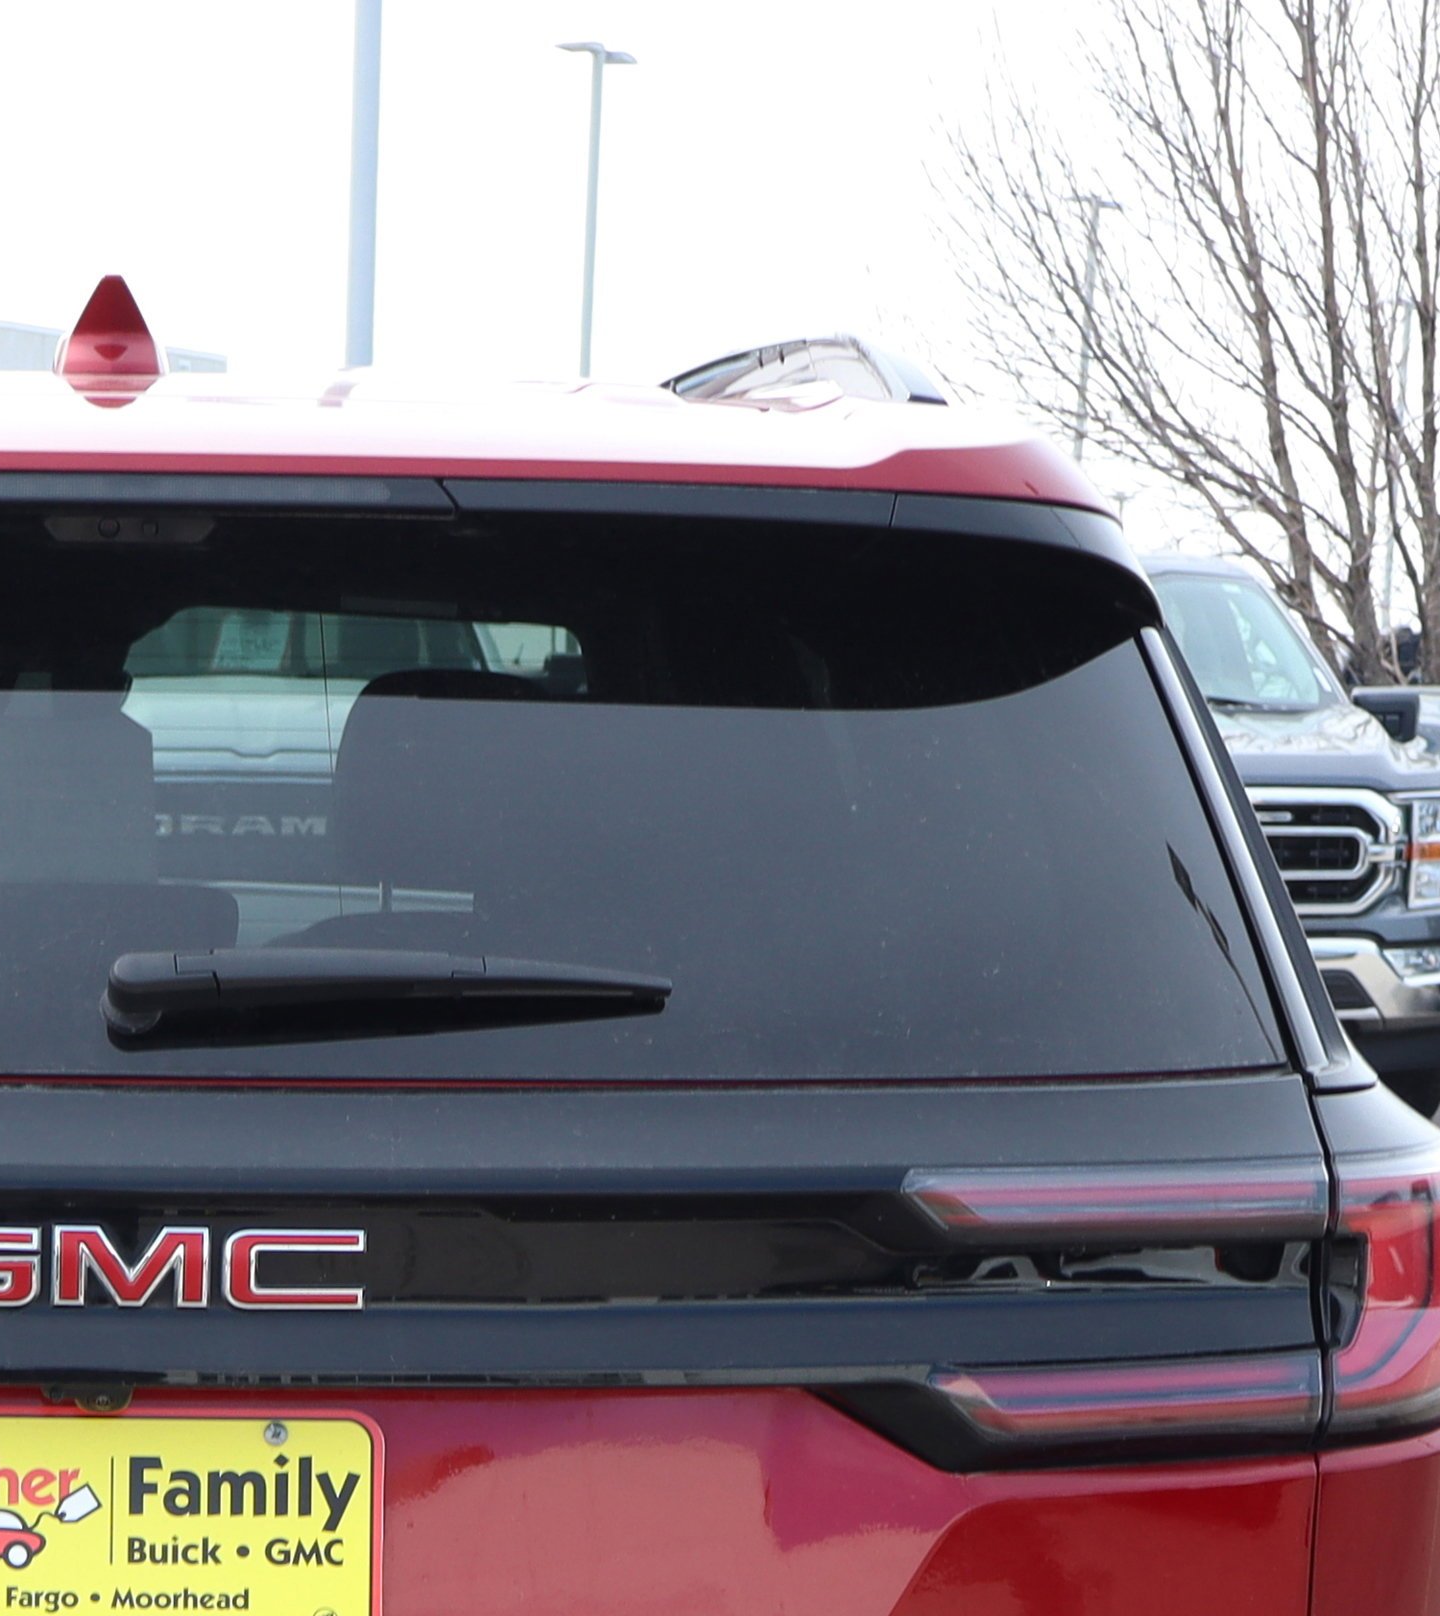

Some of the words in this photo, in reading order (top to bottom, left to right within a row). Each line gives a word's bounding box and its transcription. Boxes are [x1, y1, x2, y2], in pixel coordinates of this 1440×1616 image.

[180, 814, 328, 836] RAM
[127, 1453, 361, 1533] Family
[127, 1535, 221, 1566] Buick
[264, 1537, 344, 1567] GMC
[5, 1585, 79, 1613] Fargo
[110, 1587, 250, 1611] Moorhead
